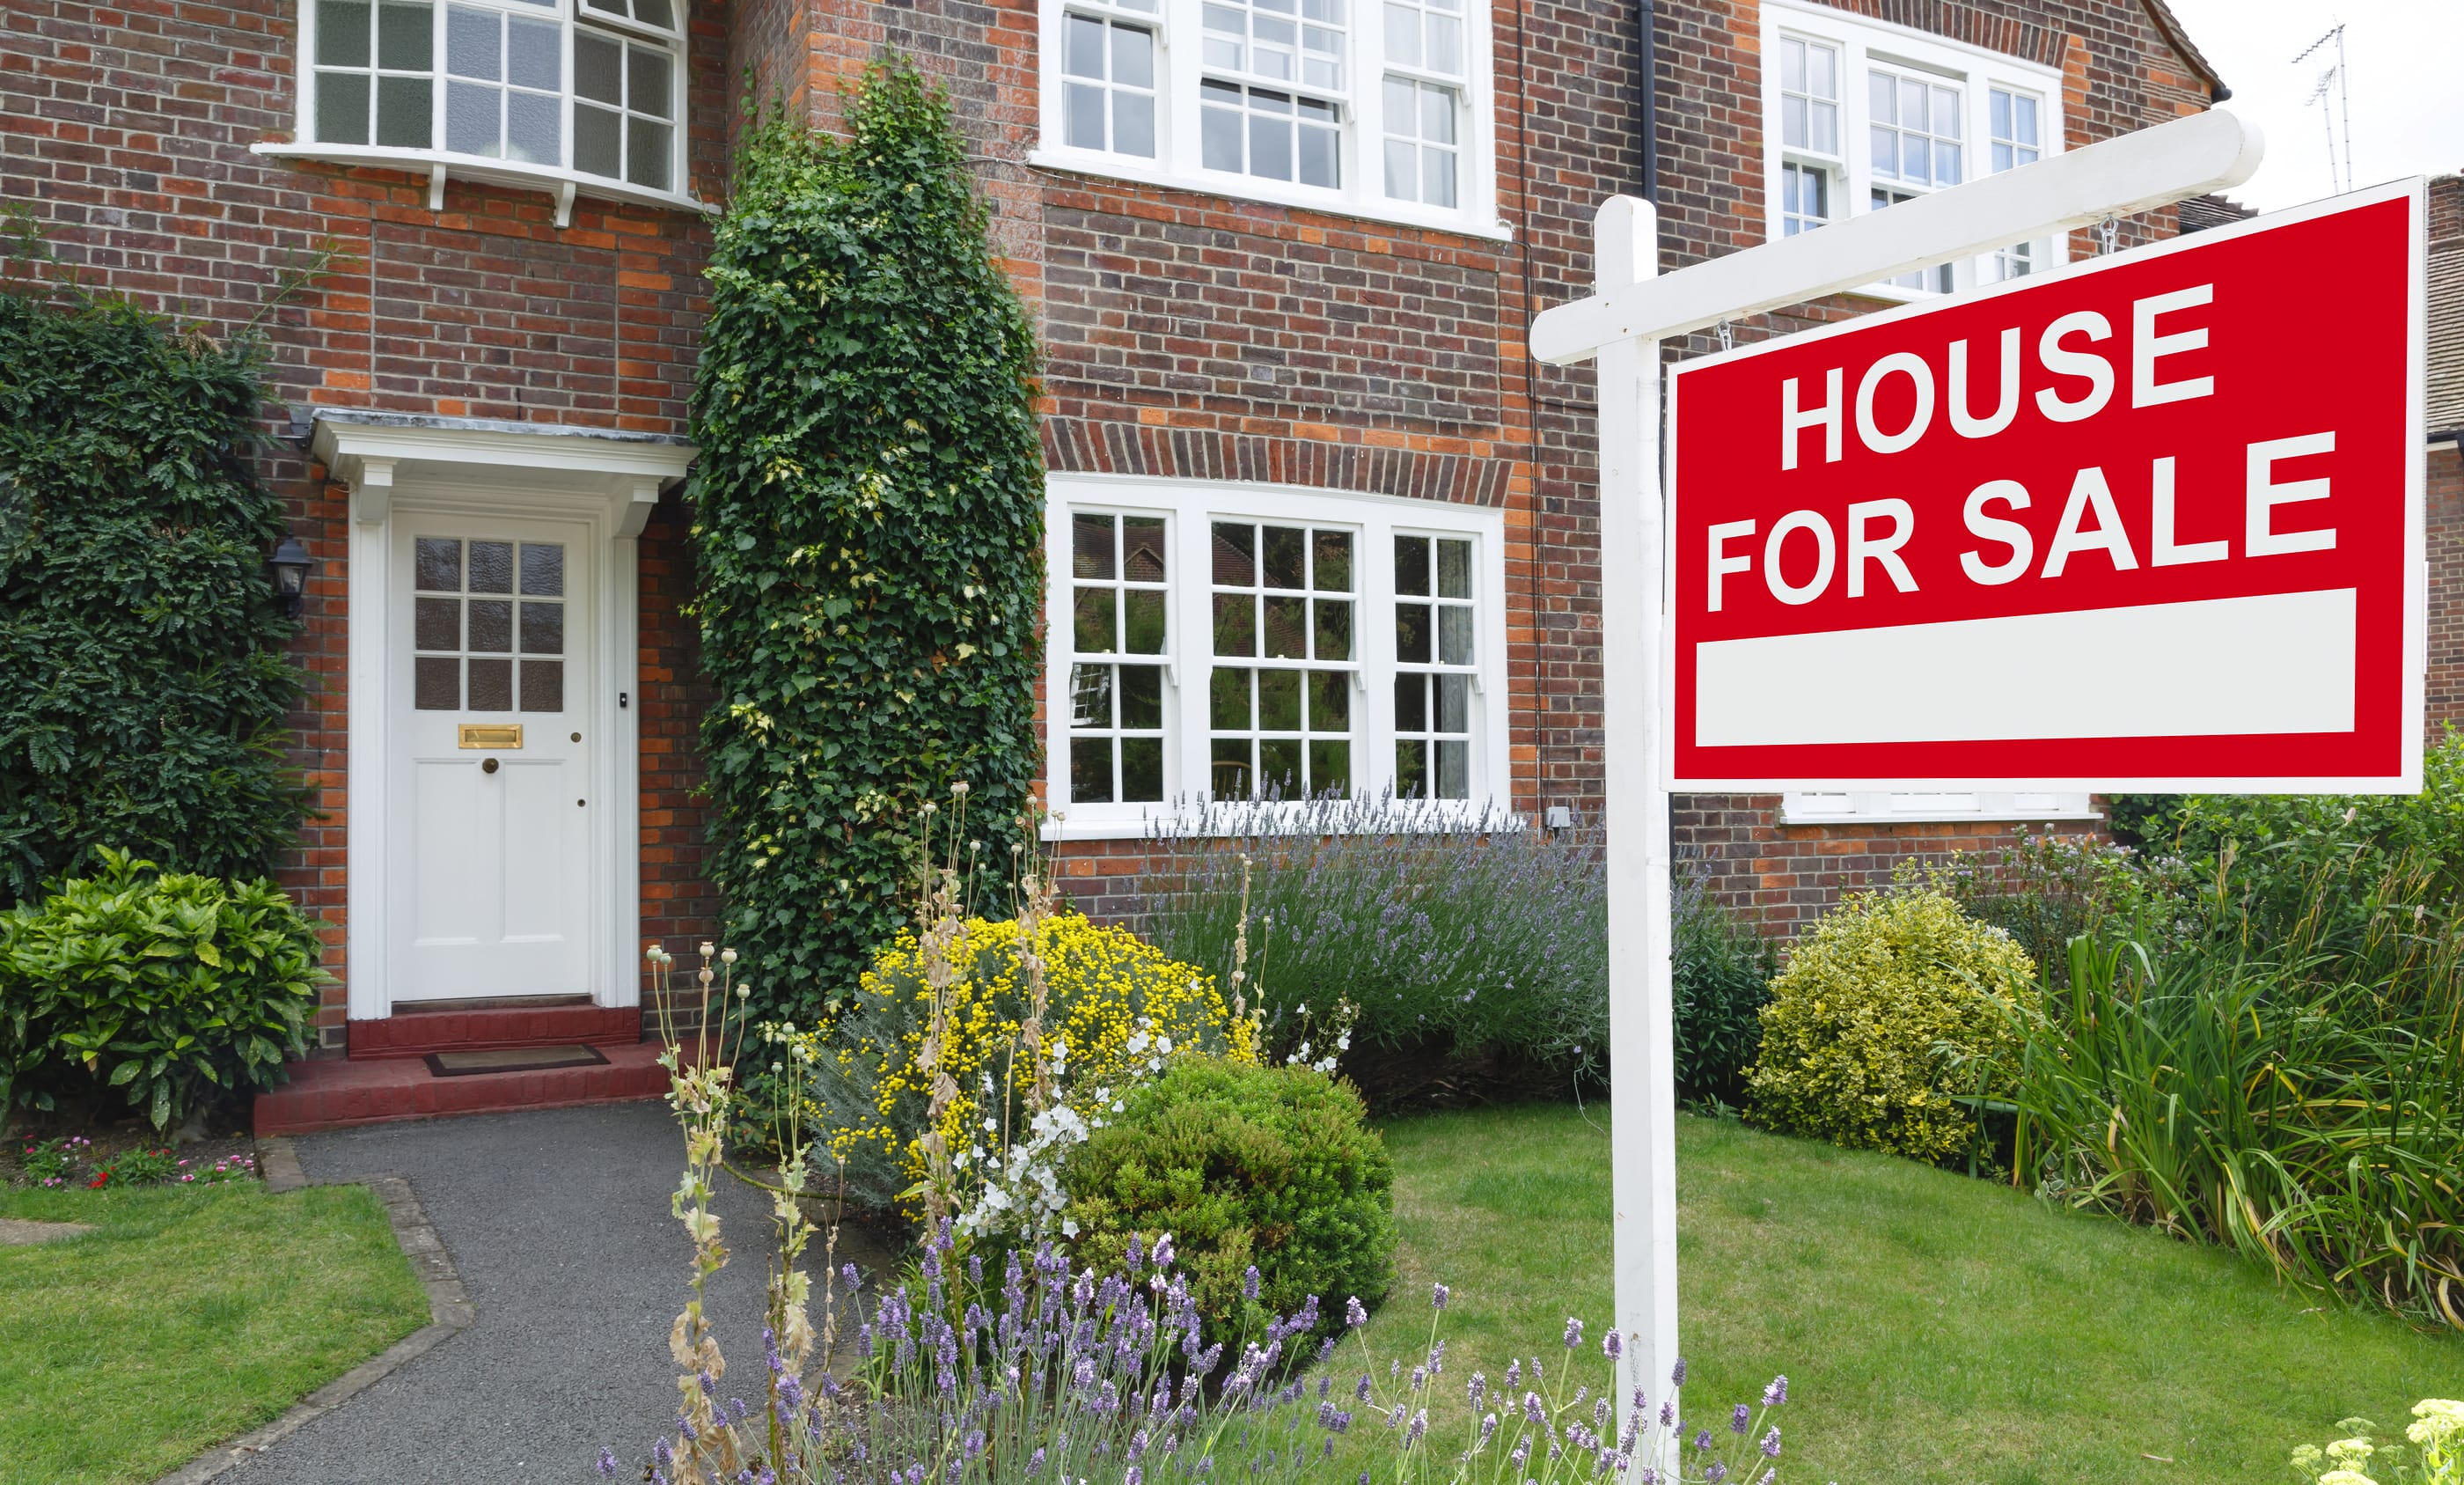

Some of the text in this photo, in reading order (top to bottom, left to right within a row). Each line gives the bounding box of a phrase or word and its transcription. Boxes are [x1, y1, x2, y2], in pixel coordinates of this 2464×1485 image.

[1782, 283, 2214, 470] HOUSE
[1708, 431, 2336, 612] FOR SALE
